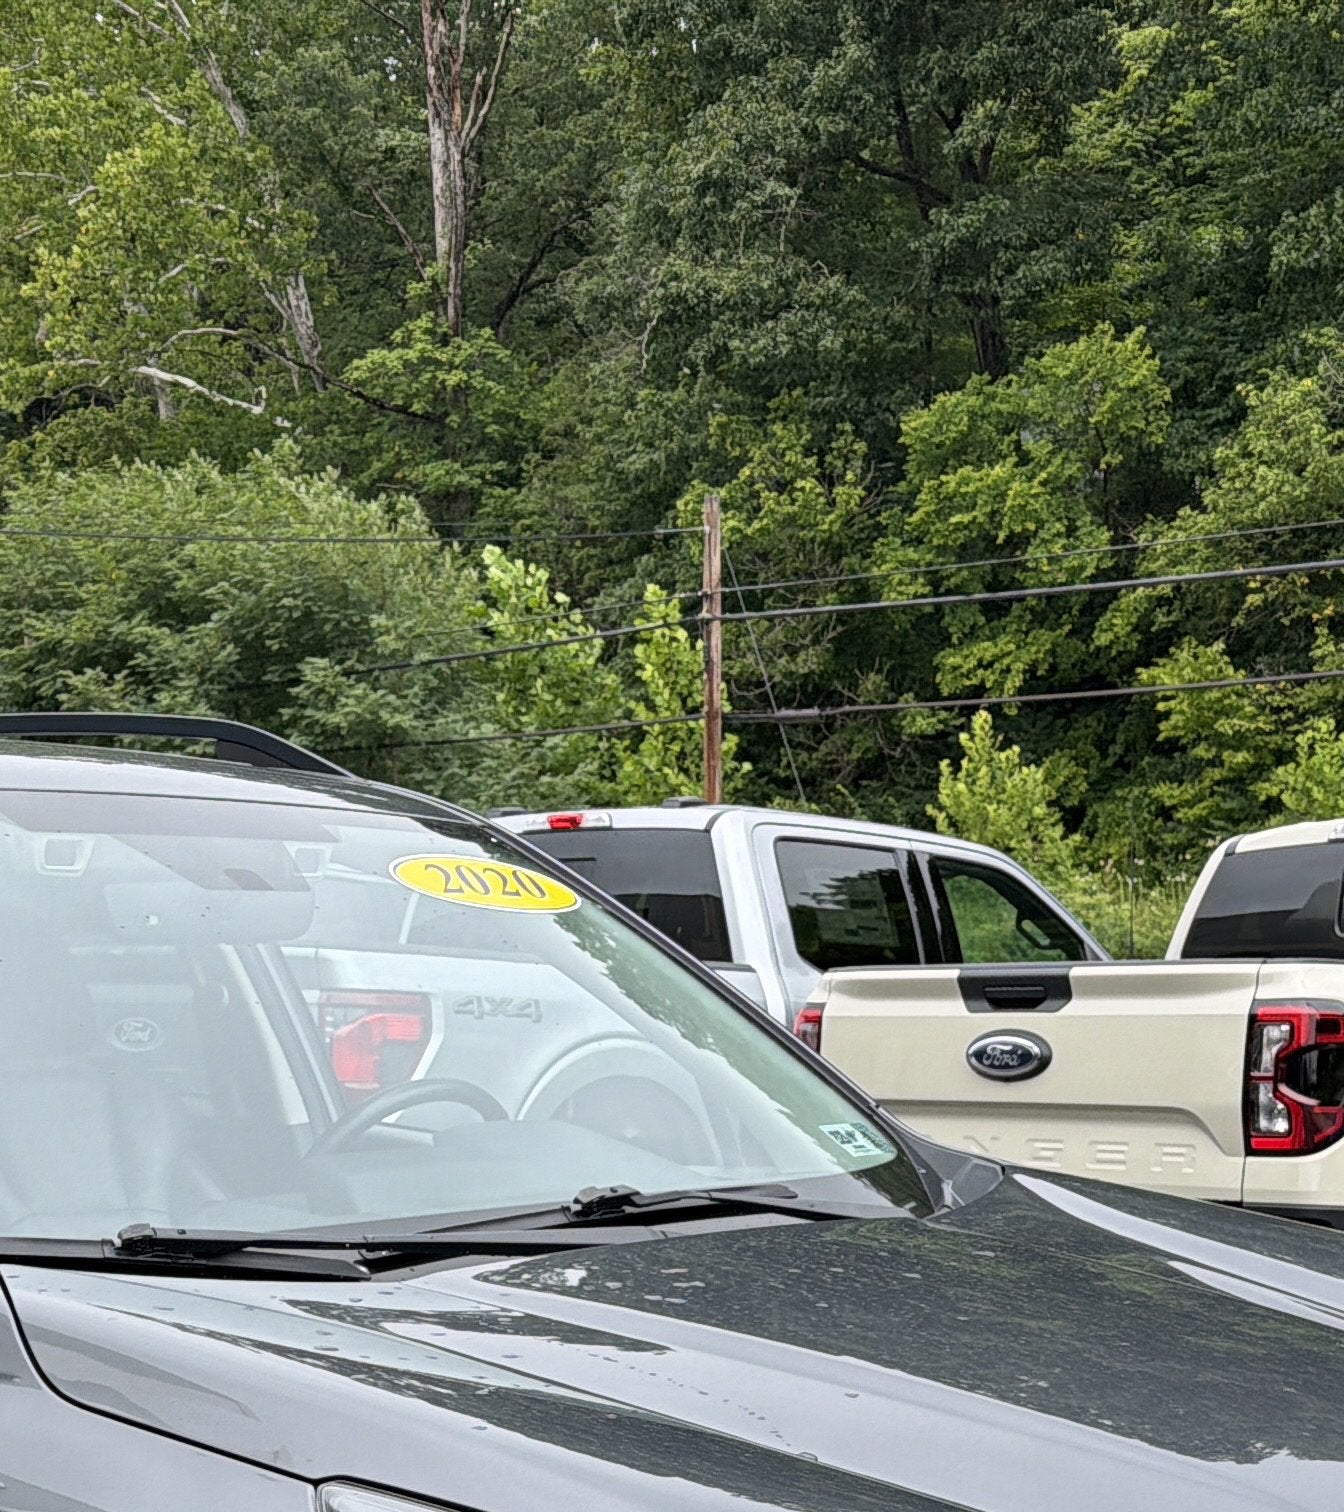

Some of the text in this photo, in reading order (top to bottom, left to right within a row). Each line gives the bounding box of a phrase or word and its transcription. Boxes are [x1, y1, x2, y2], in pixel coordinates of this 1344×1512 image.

[424, 863, 547, 899] 2020
[982, 1044, 1023, 1066] Ford
[962, 1134, 1198, 1173] NGER
